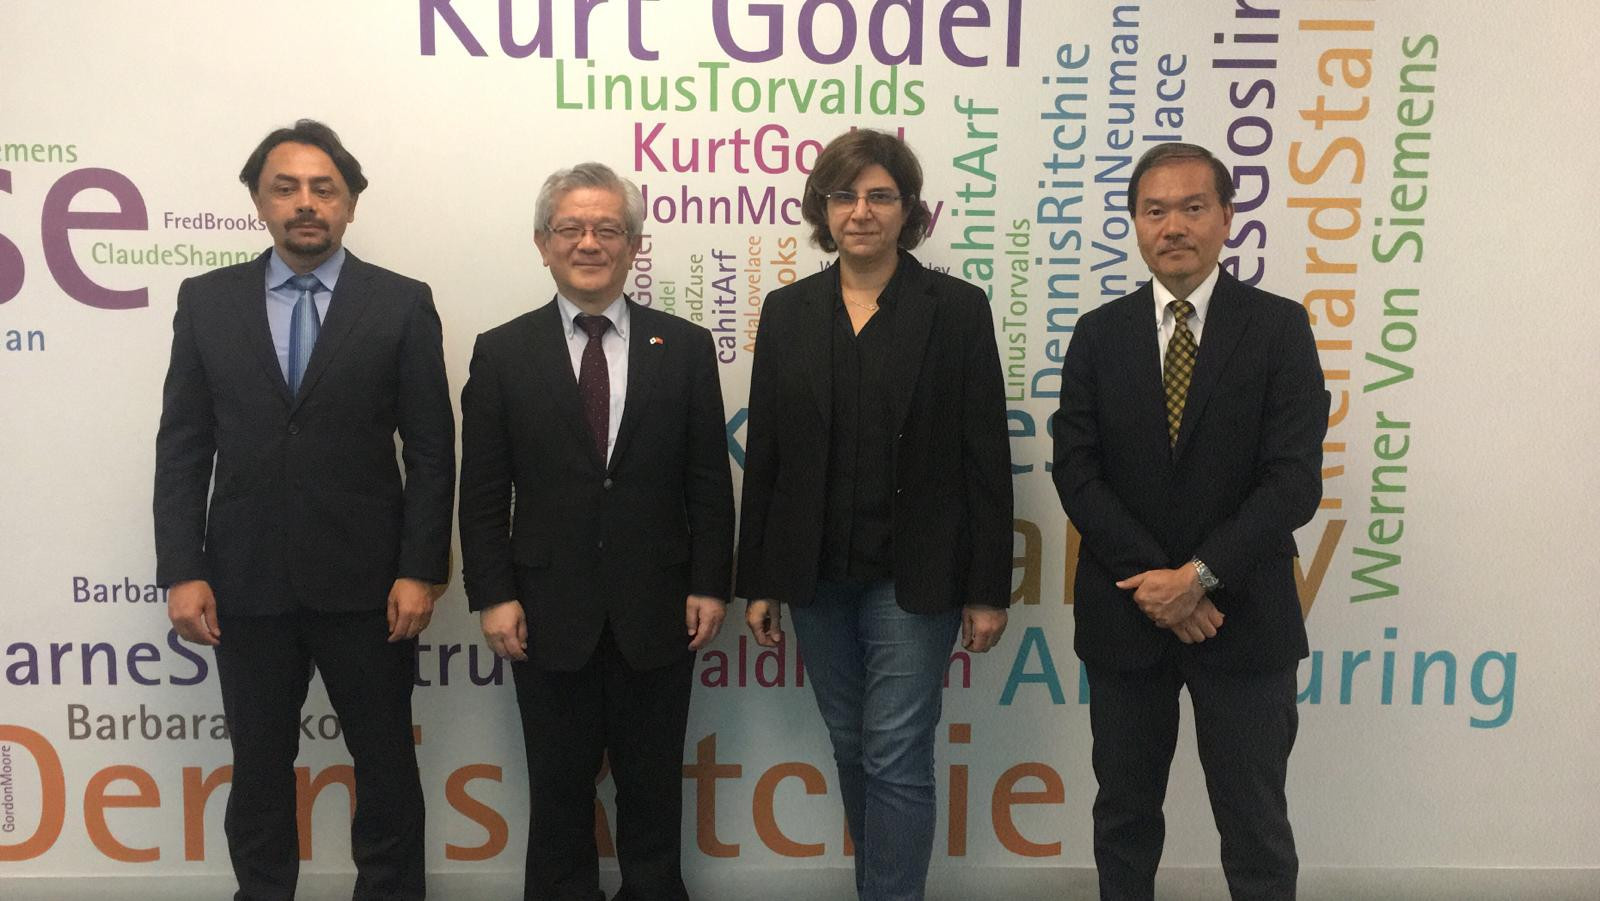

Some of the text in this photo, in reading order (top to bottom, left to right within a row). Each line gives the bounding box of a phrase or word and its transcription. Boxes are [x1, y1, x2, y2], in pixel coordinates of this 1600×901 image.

[555, 58, 926, 116] LinusTorvalds
[0, 143, 78, 163] mens
[633, 122, 906, 175] KurtGo
[163, 212, 267, 231] FredBrooks
[950, 94, 999, 302] ahitArf
[1031, 43, 1090, 399] DennisRitchie
[91, 242, 262, 267] ClaudeShanno
[711, 248, 737, 364] cahitArf
[1003, 218, 1031, 400] LinusTorvalds
[1349, 33, 1439, 604] Werner Von Siemens
[0, 744, 16, 834] GordonMoore
